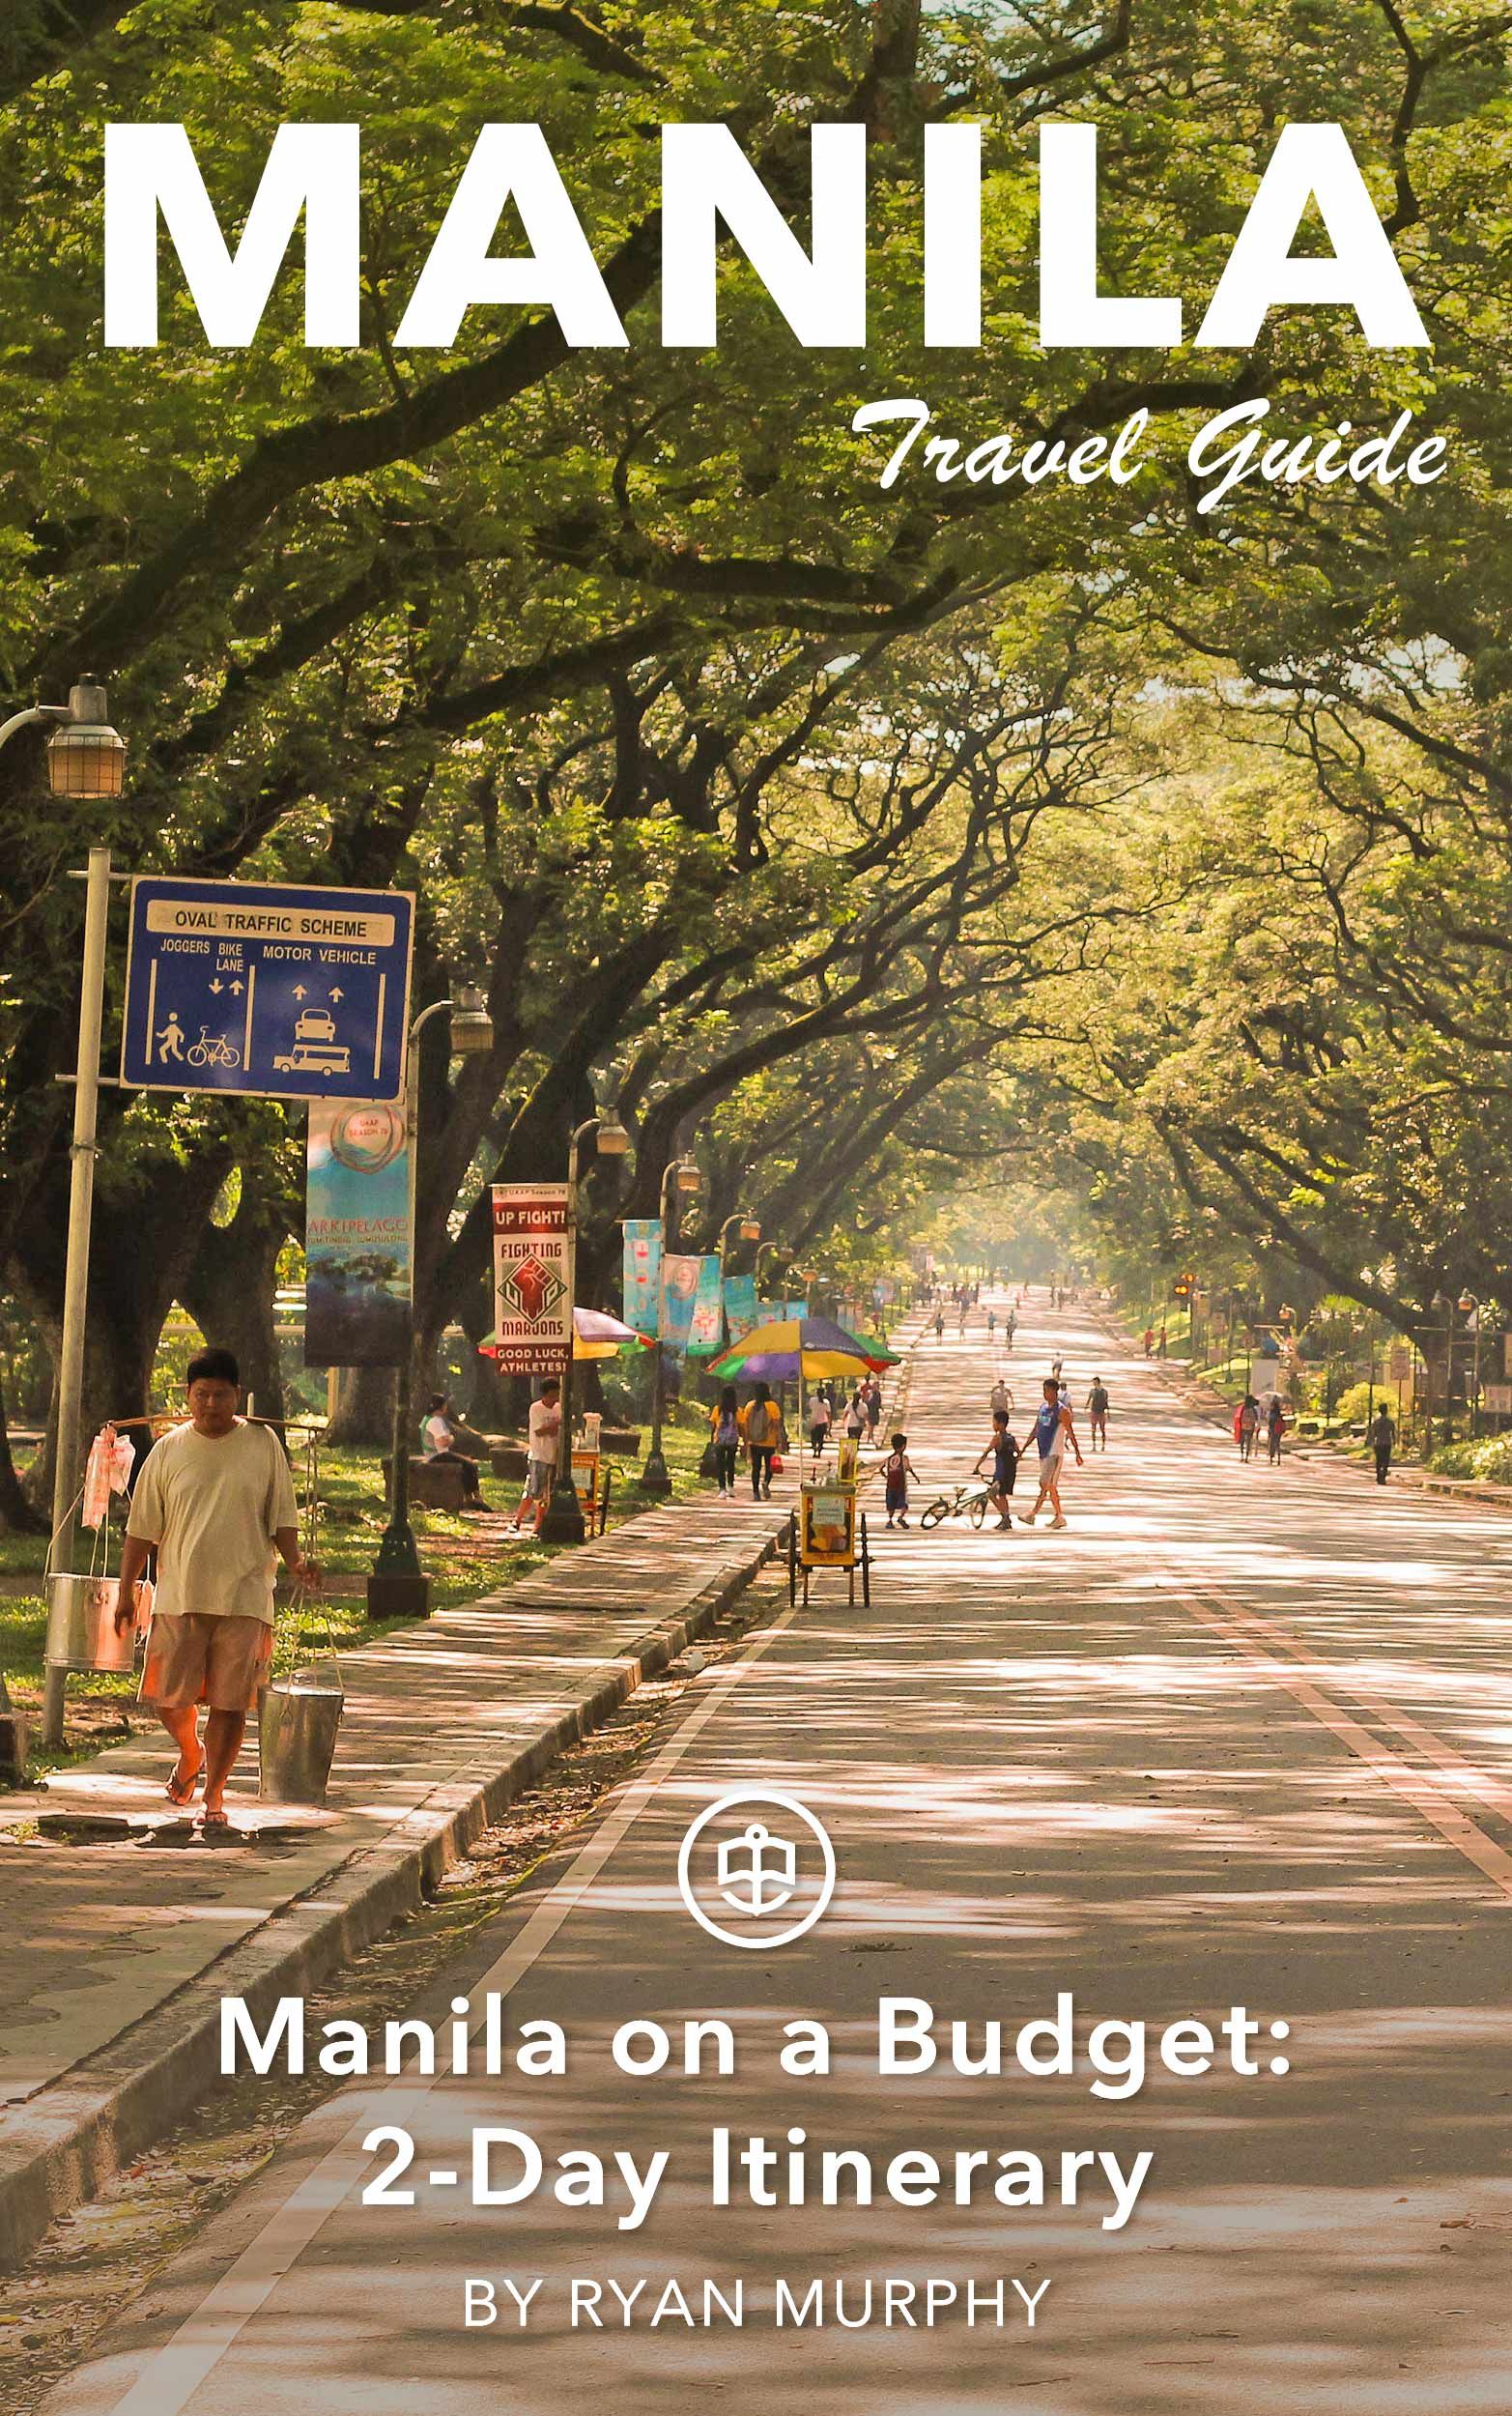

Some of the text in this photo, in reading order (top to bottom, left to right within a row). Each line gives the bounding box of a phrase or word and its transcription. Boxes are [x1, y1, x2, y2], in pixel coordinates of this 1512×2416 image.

[175, 910, 367, 937] OVAL TRAFFIC SCHEME
[160, 938, 242, 957] JOGGERS BIKE
[262, 945, 377, 965] MOTOR VEHICLE
[215, 958, 243, 972] LANE
[496, 1210, 565, 1225] UP FIGHT!
[501, 1243, 562, 1258] FIGHTING
[501, 1320, 563, 1336] MAROONS
[498, 1347, 569, 1360] GOOD LUCK,
[499, 1361, 567, 1372] ATHLETES!
